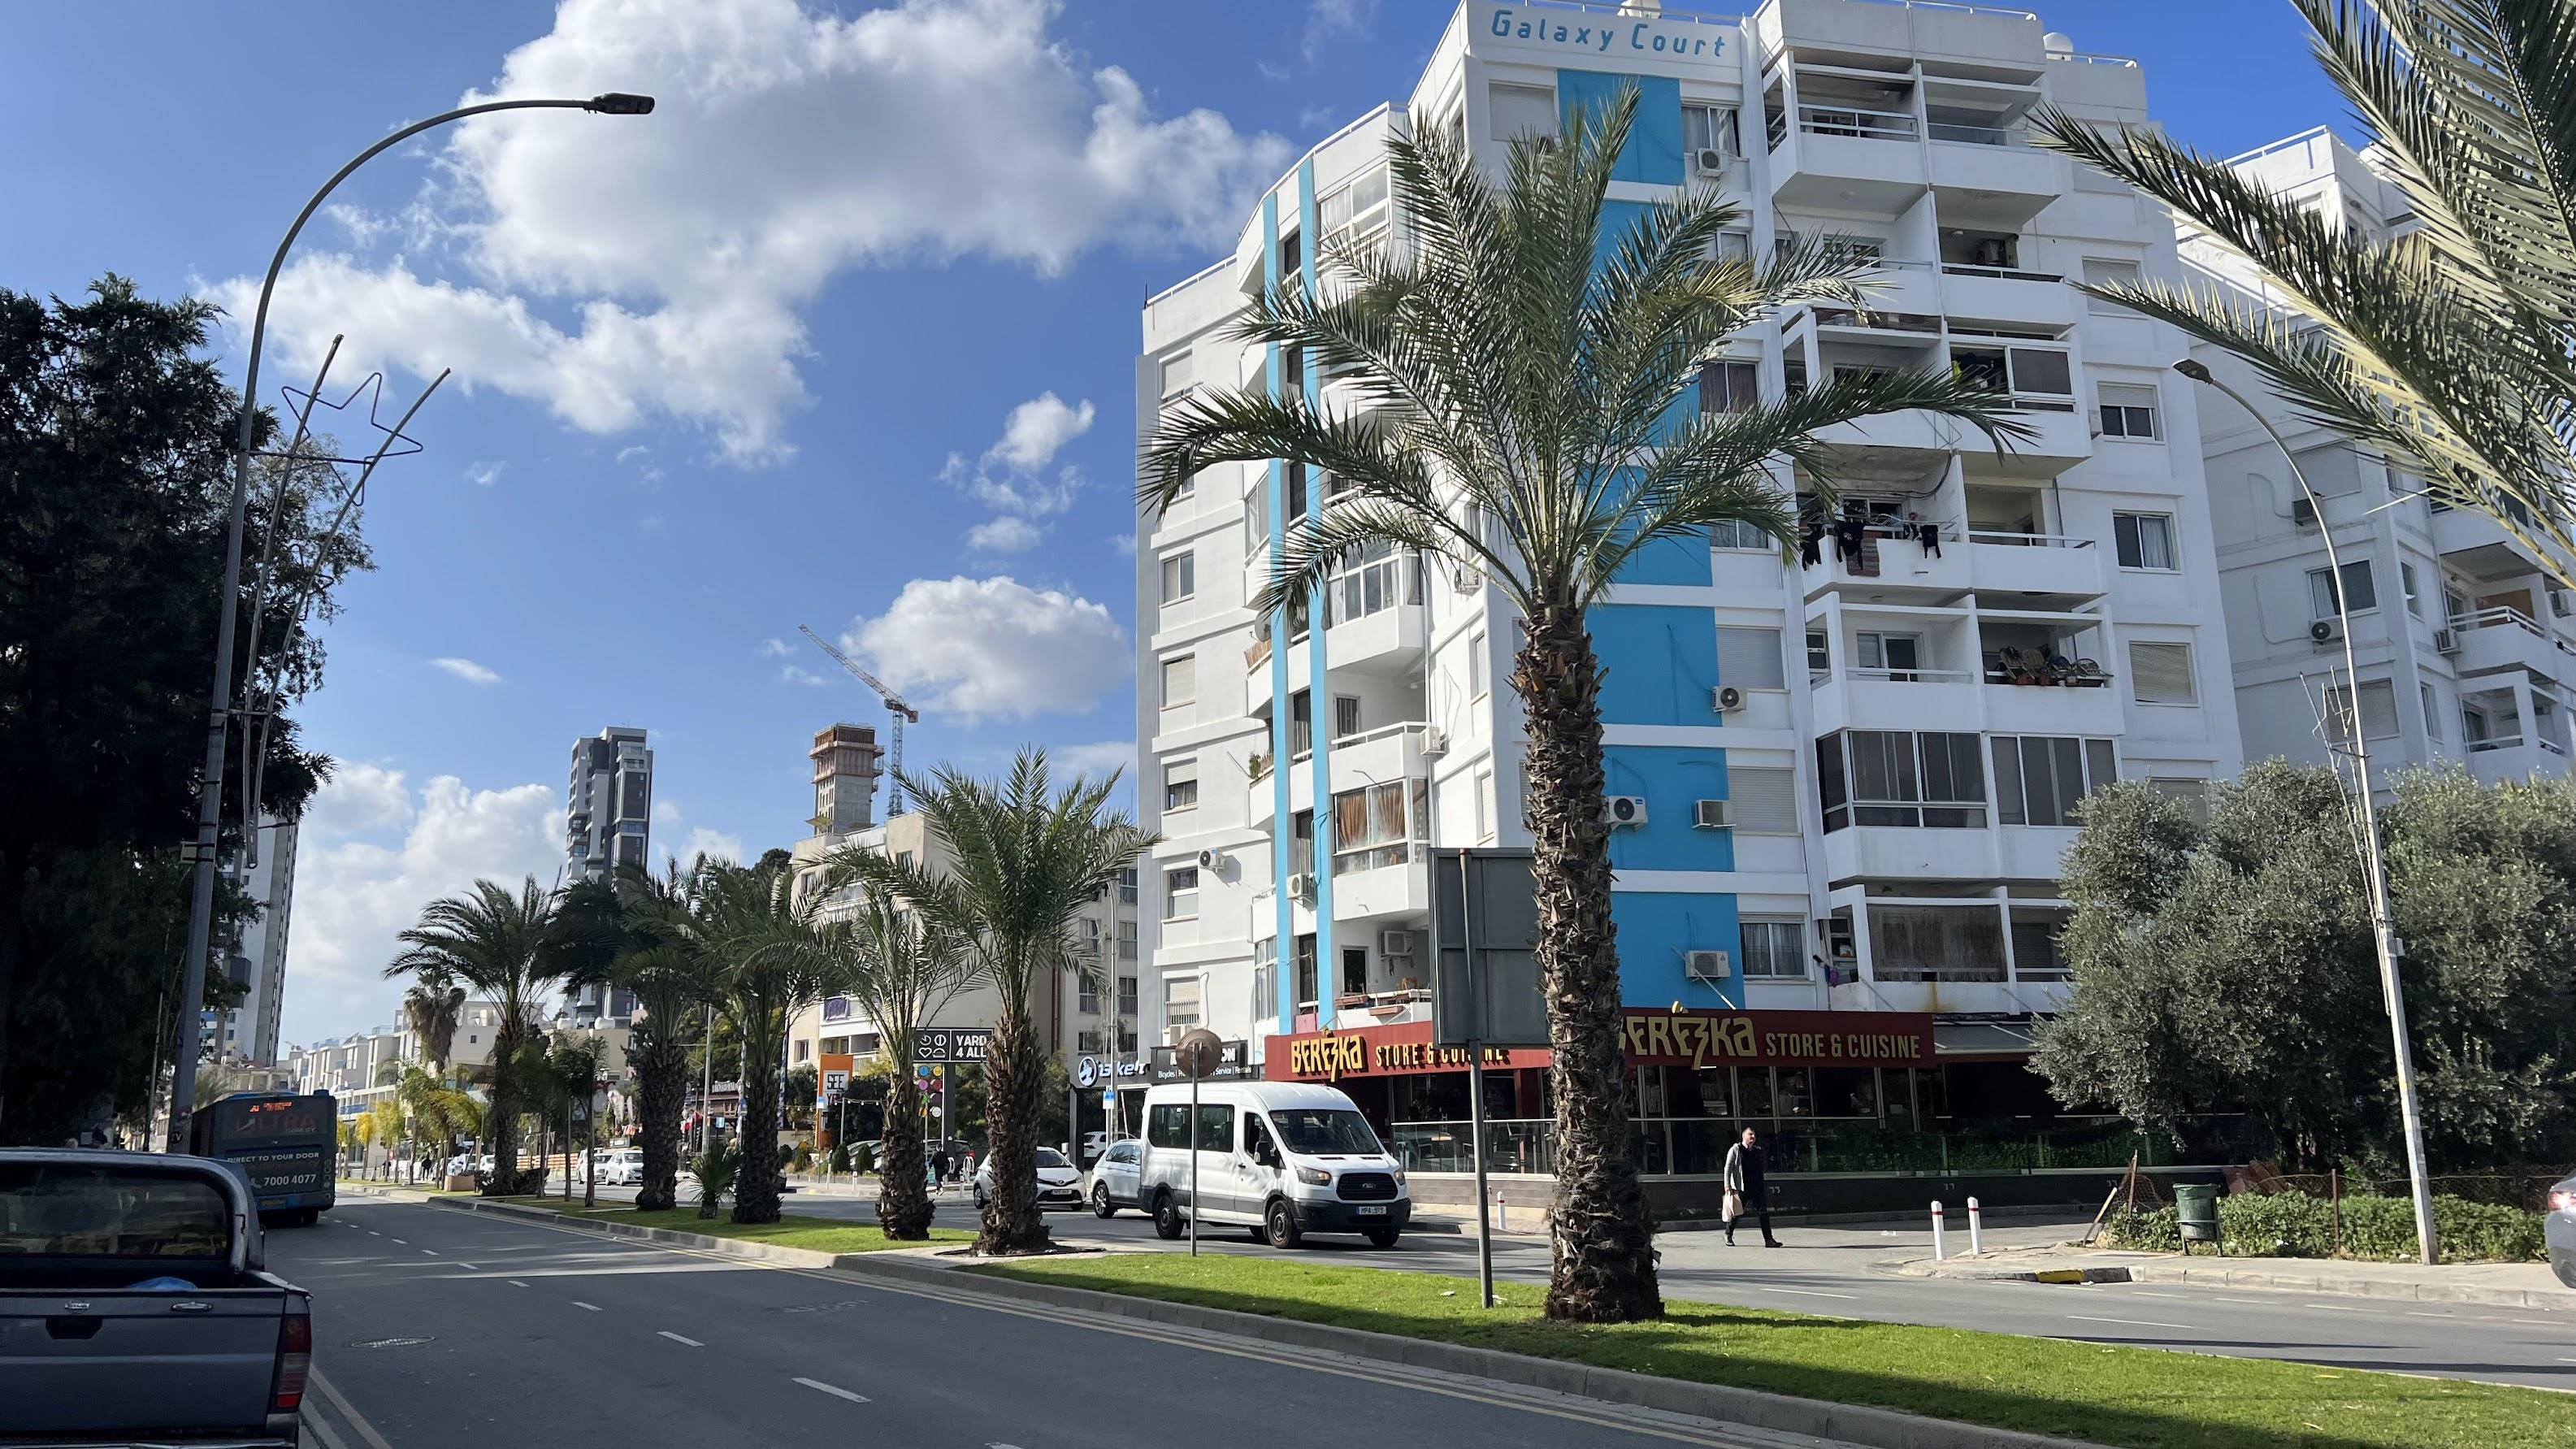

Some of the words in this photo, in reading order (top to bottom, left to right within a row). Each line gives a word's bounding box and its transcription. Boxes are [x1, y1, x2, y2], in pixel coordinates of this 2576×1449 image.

[1491, 9, 1614, 52] Galaxy
[1631, 23, 1725, 57] Court
[956, 1035, 987, 1047] YARD
[1766, 1033, 1825, 1058] STORE
[1831, 1034, 1842, 1058] &
[1848, 1034, 1921, 1059] CUISINE
[956, 1047, 964, 1058] 4
[966, 1047, 987, 1058] ALL
[1375, 1043, 1419, 1067] STORE
[1426, 1041, 1434, 1065] &
[1216, 1067, 1232, 1075] Service
[827, 1074, 844, 1090] SEE
[263, 1176, 289, 1187] 7000
[291, 1174, 317, 1184] 4077
